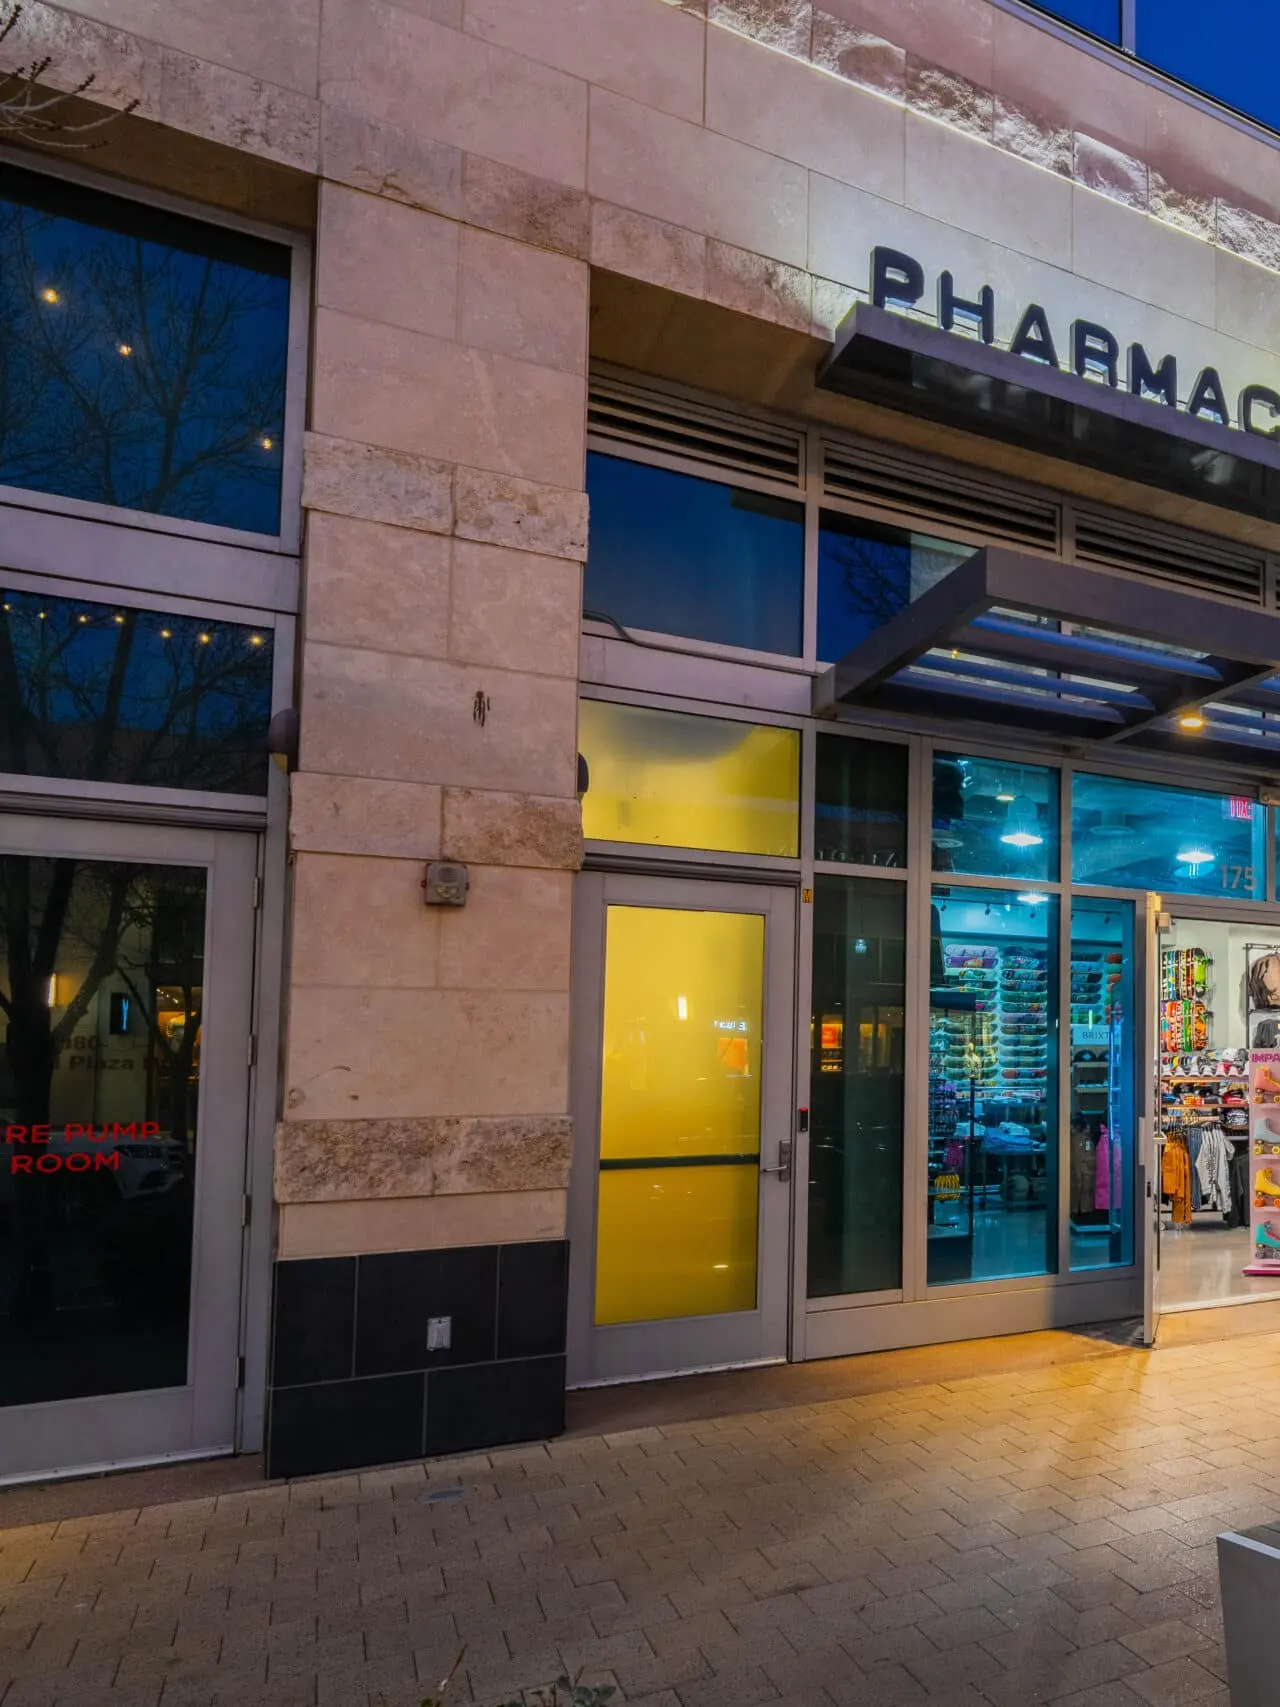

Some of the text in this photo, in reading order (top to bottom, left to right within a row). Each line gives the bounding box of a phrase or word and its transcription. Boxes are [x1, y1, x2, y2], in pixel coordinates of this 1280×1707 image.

[1222, 864, 1257, 891] 175
[64, 1121, 160, 1144] PUMP
[11, 1151, 120, 1175] ROOM
